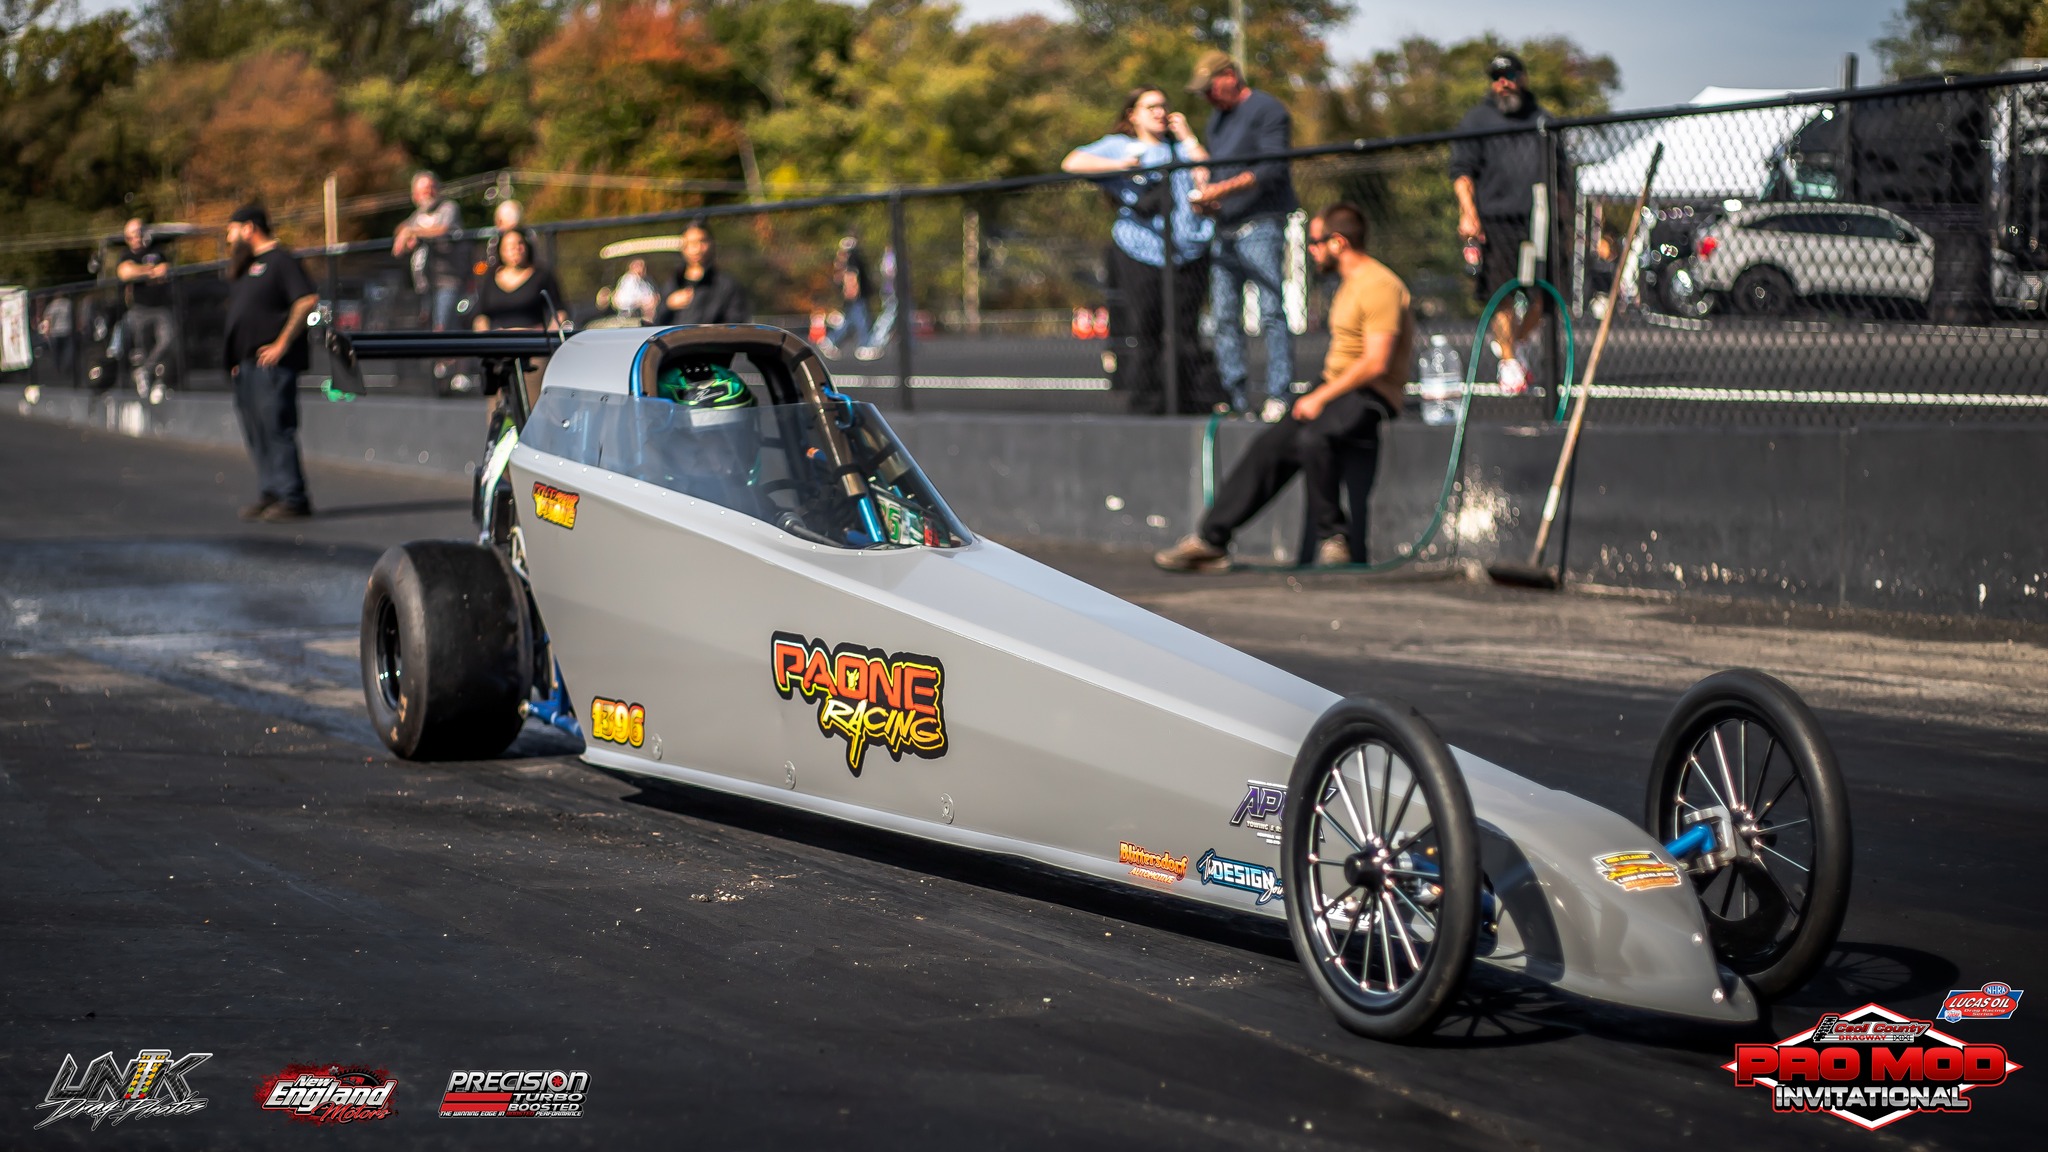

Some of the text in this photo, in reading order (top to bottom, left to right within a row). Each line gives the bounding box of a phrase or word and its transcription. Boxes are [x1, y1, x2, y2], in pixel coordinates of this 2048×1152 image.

[773, 639, 941, 715] PAONE
[592, 698, 644, 747] 1396
[822, 698, 942, 767] RACING
[1129, 867, 1176, 884] AUTOMOTIVE
[1211, 860, 1275, 890] DESIGN
[1620, 853, 1650, 861] ATLANTIC
